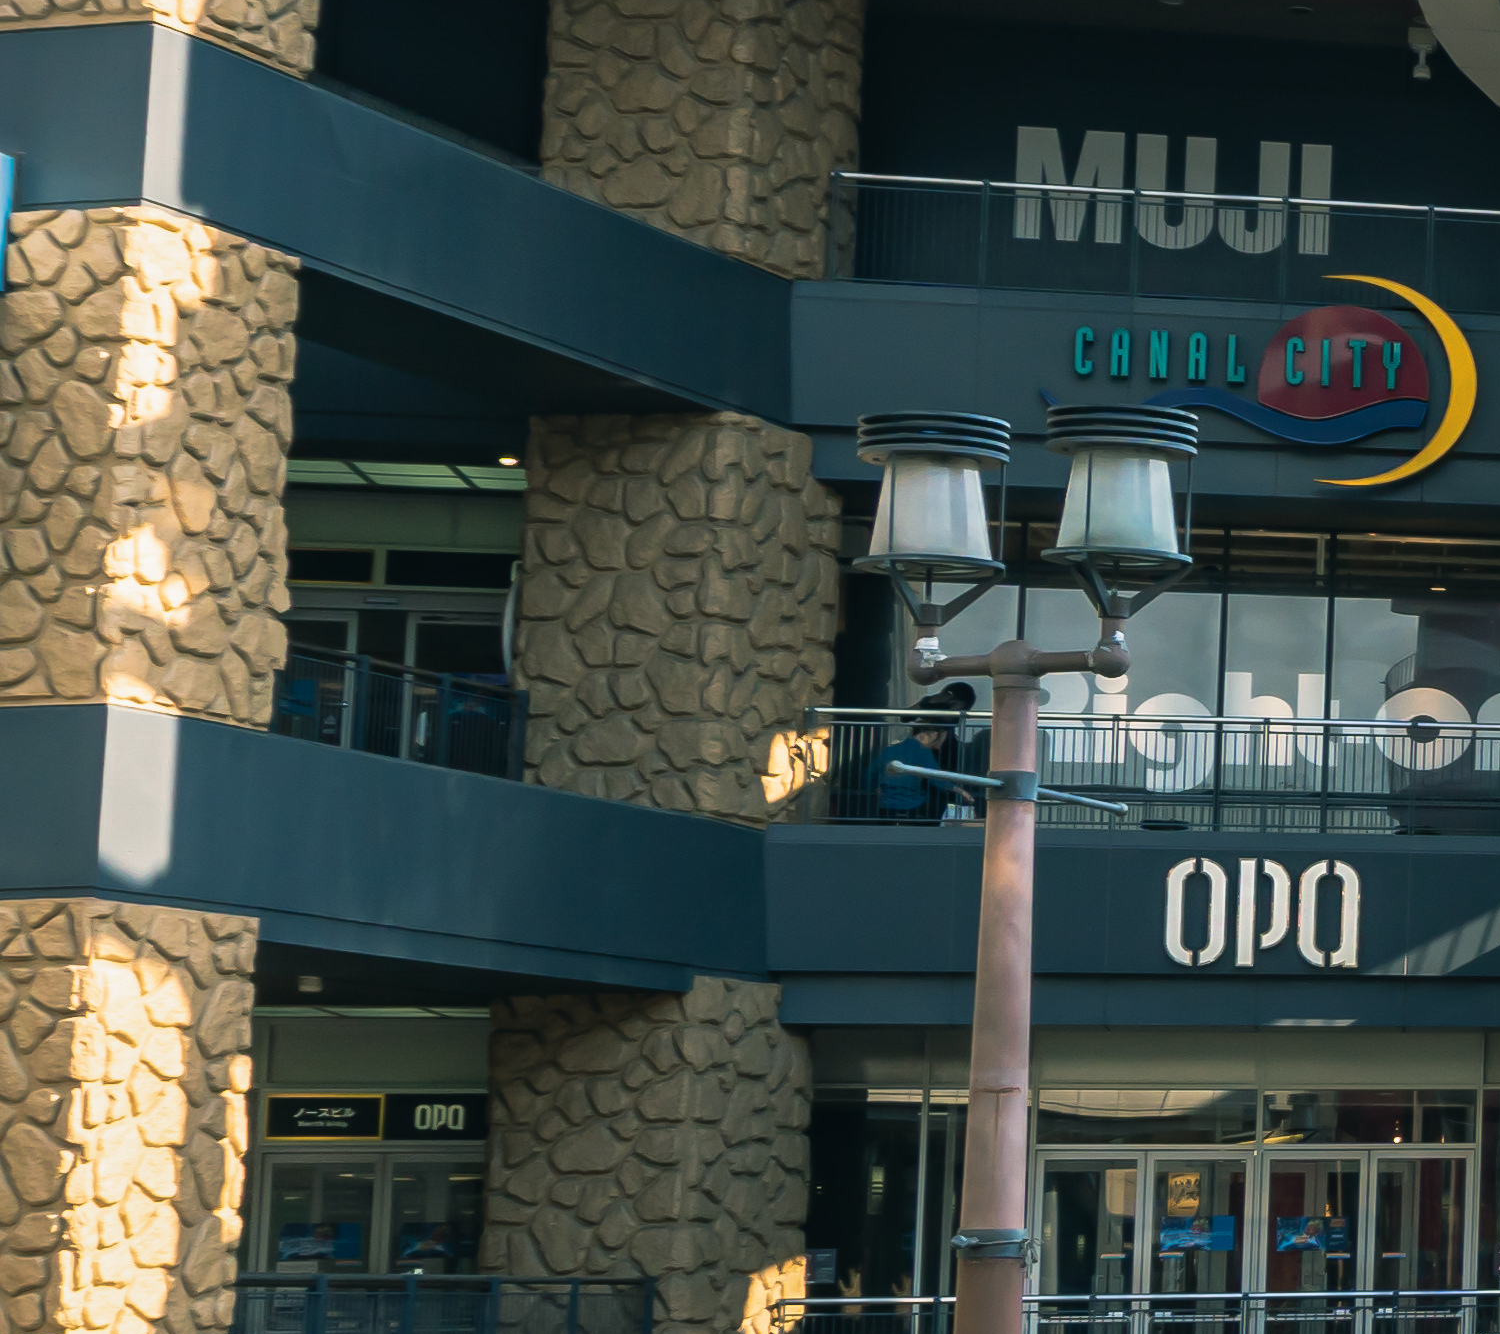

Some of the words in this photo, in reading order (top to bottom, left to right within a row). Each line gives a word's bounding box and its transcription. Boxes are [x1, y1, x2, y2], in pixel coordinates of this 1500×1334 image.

[1013, 125, 1333, 256] MUJI
[1073, 325, 1247, 384] CANAL
[1285, 336, 1403, 390] CITY
[1163, 857, 1362, 968] OPA
[414, 1104, 465, 1130] OPA
